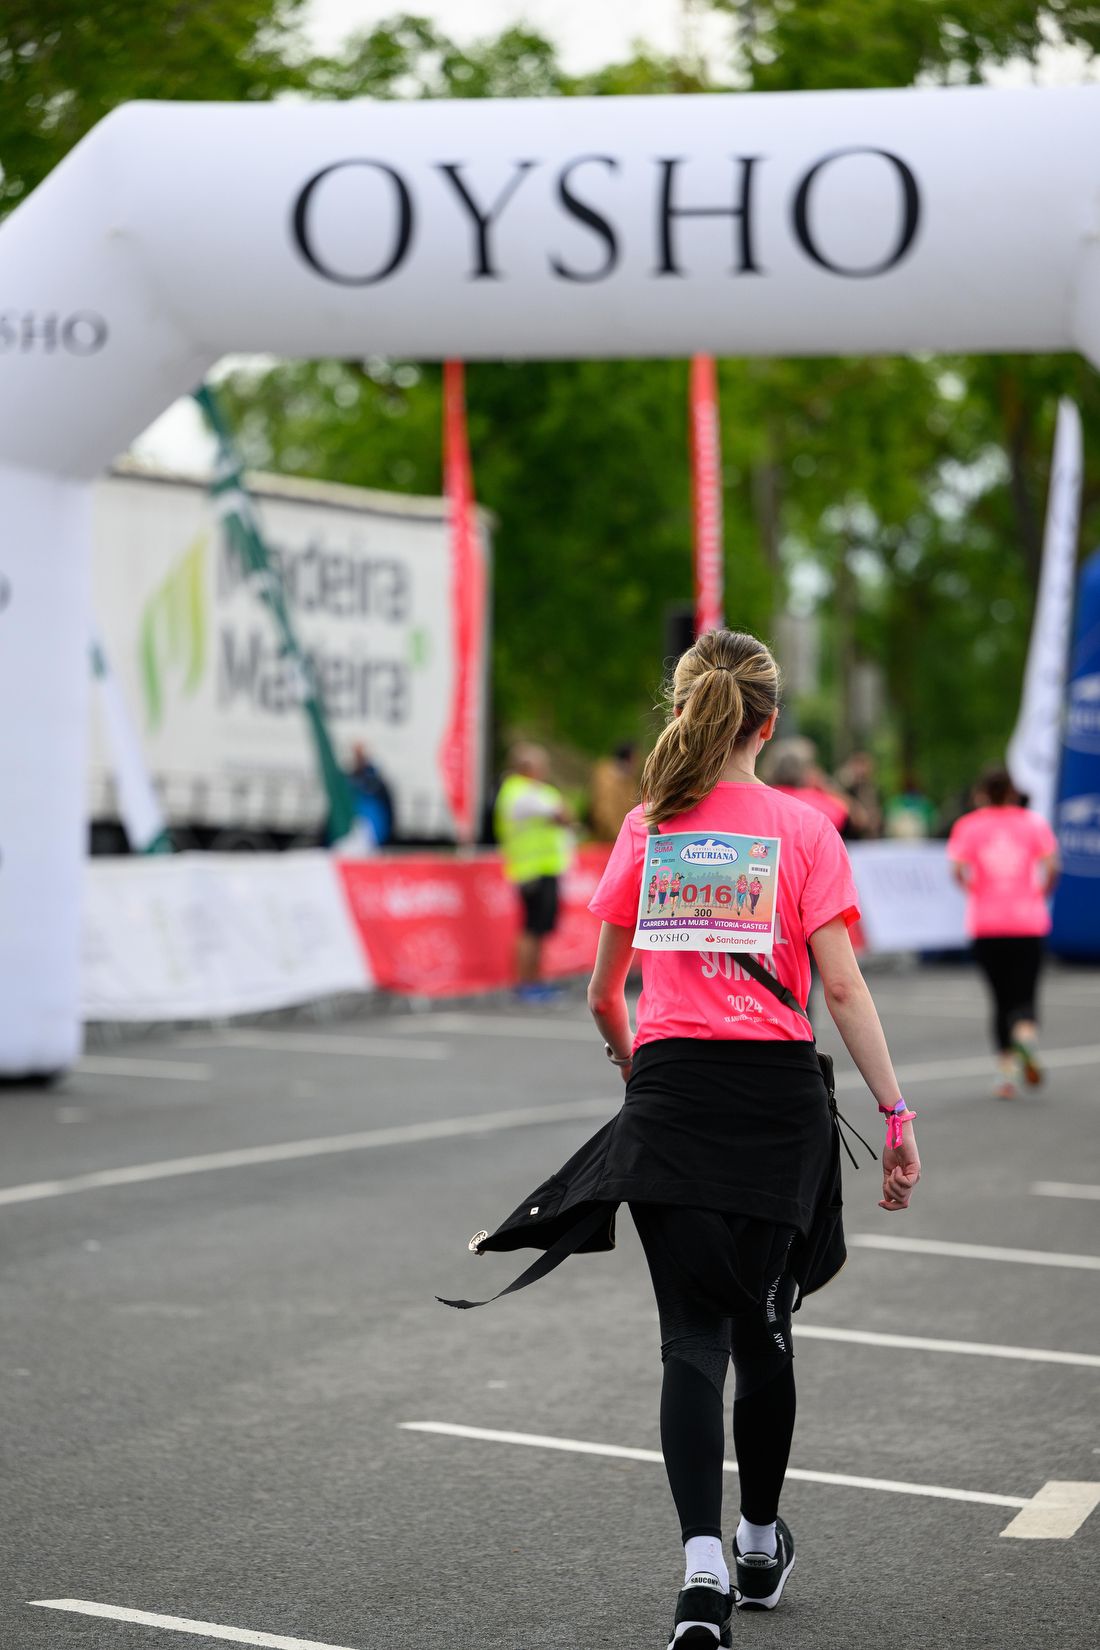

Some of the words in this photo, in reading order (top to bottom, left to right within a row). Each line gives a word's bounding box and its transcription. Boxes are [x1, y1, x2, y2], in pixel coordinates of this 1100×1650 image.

[290, 147, 923, 286] OYSHO
[683, 849, 734, 861] ASTURIANA
[682, 884, 732, 904] 016
[694, 908, 712, 917] 300
[643, 919, 669, 928] CARRERA
[649, 932, 690, 943] OYSHO
[716, 935, 757, 945] Santander
[727, 994, 763, 1013] 2024
